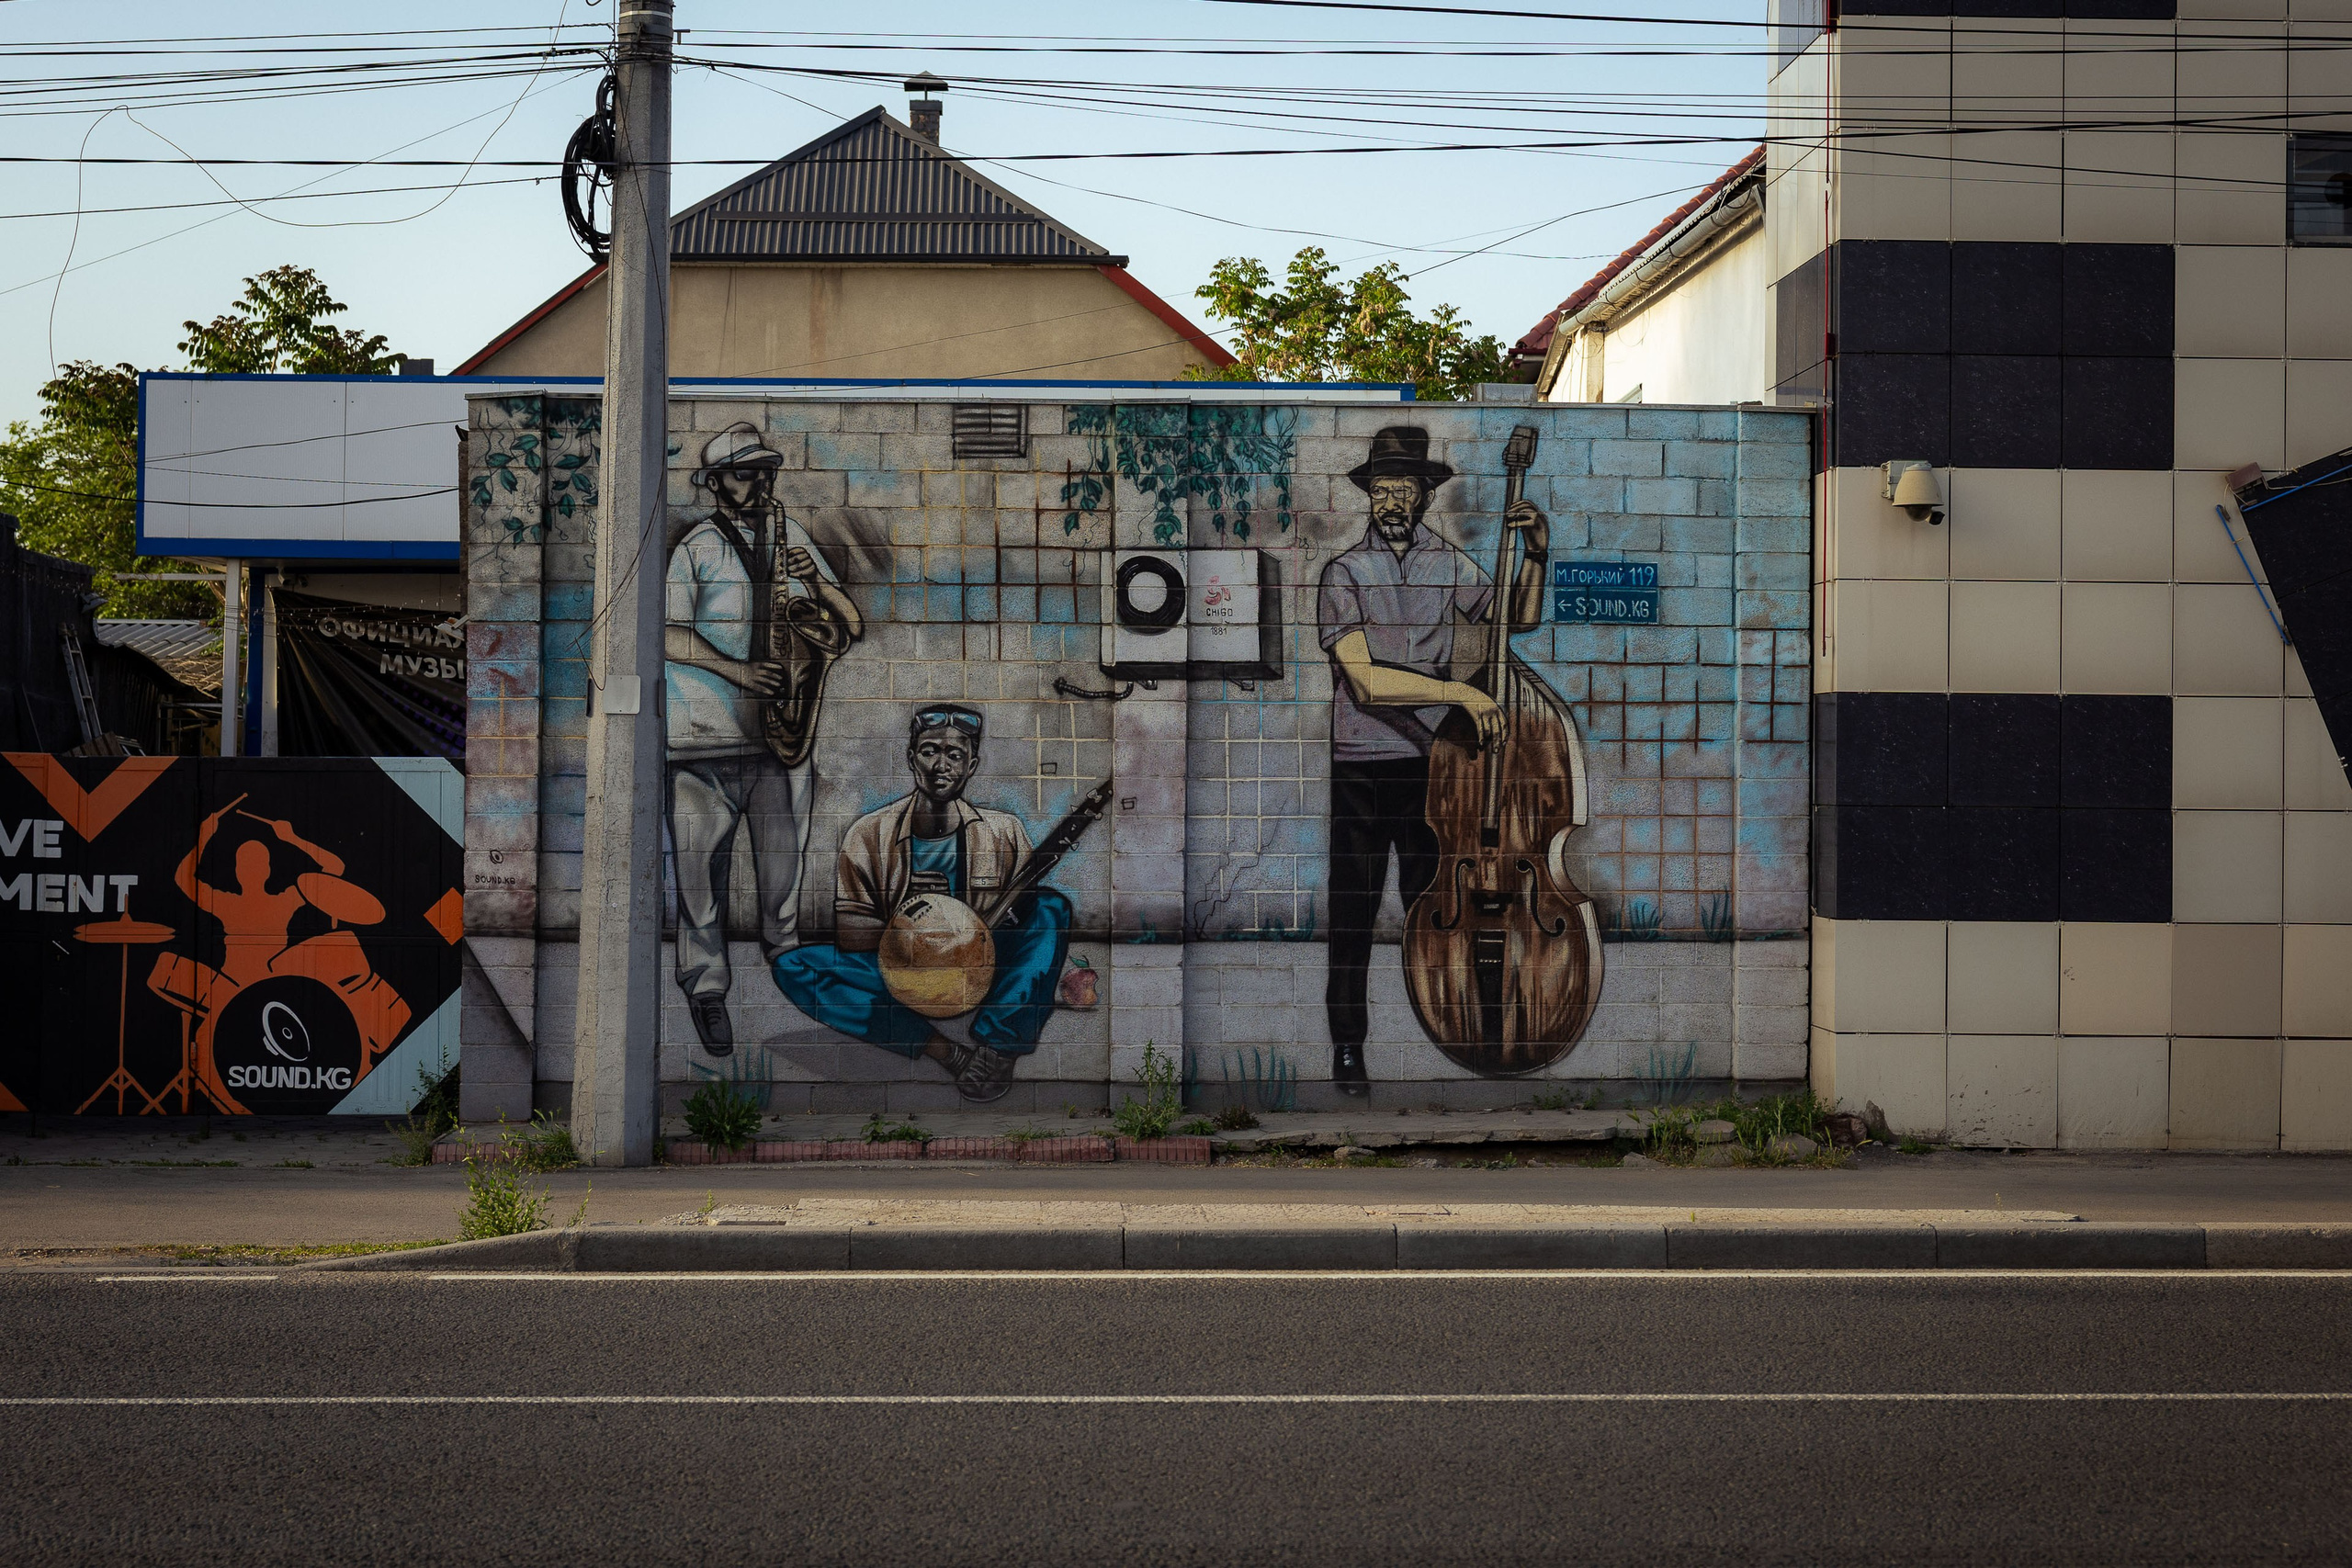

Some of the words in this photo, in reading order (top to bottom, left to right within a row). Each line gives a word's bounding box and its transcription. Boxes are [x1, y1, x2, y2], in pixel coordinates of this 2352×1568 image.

[1628, 566, 1655, 586] 119
[1205, 607, 1233, 617] CHIGO
[1576, 596, 1650, 618] SOUND.KG
[1210, 626, 1227, 636] 1881
[379, 654, 465, 680] МУЗЫ
[228, 1065, 352, 1090] SOUND.KG
